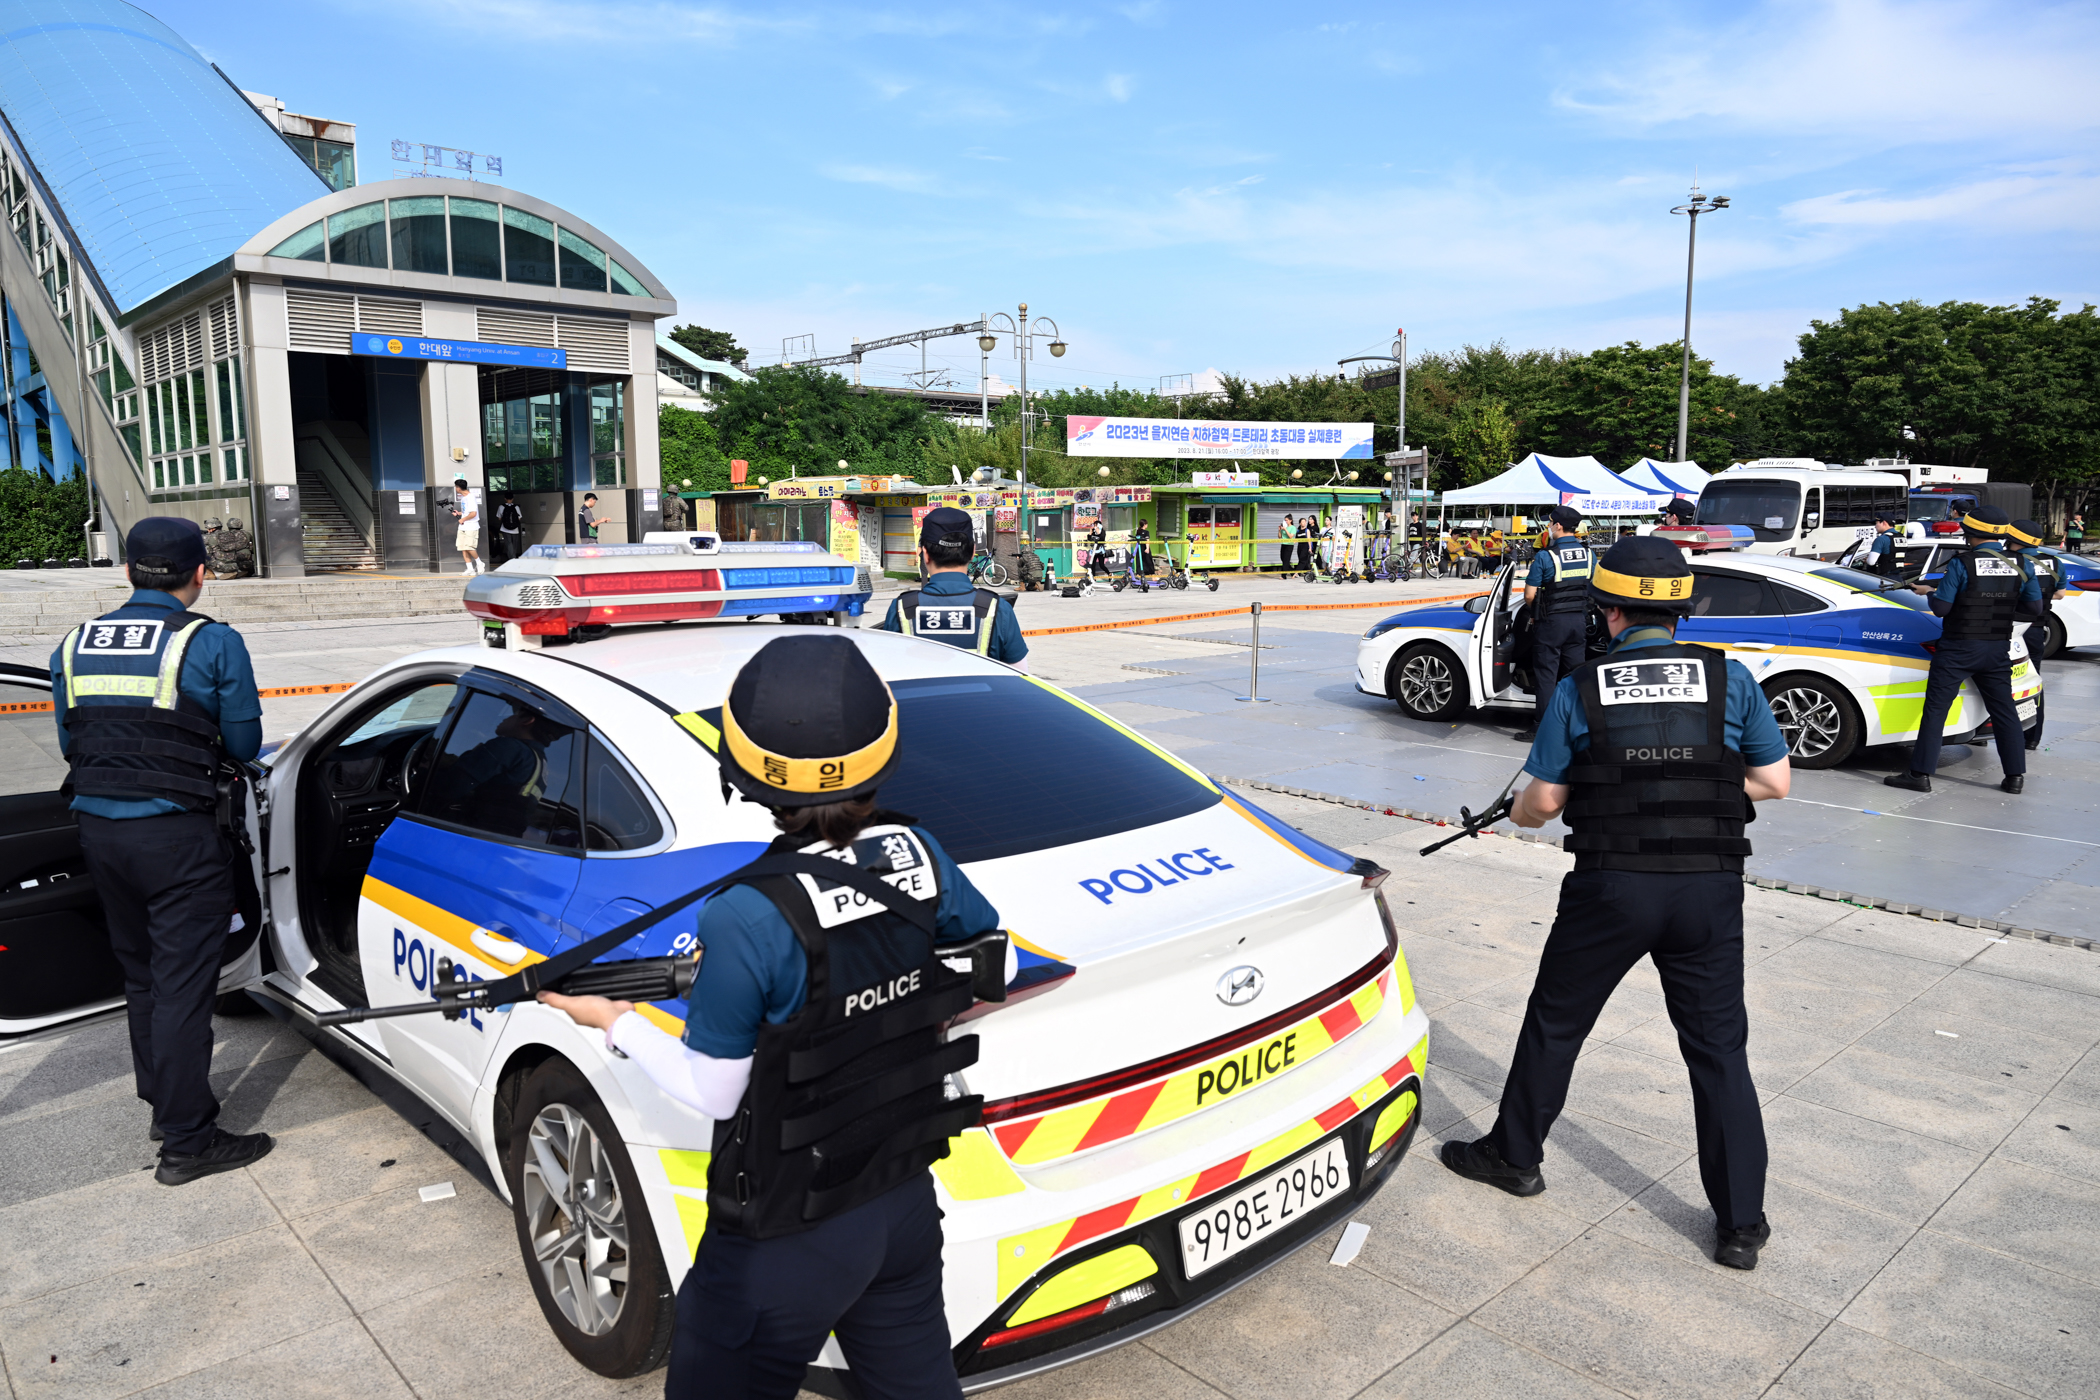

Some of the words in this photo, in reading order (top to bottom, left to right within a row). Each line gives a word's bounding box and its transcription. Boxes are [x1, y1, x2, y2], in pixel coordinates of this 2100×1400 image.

[418, 341, 453, 358] 한대앞
[456, 345, 482, 354] Hanyang
[551, 352, 559, 364] 2
[1106, 424, 1149, 441] 2023년
[1152, 425, 1190, 442] 을지연습
[1192, 426, 1230, 443] 지하철역
[1232, 427, 1268, 443] 드론테러
[1270, 428, 1306, 444] 초동대응
[1308, 428, 1342, 444] 실제훈련
[778, 486, 807, 497] 아메리카노
[137, 564, 164, 573] POLICE
[1639, 578, 1683, 597] 통일
[925, 611, 965, 629] 경찰
[93, 625, 147, 648] 경찰
[1861, 631, 1891, 640] 안산상록
[1891, 633, 1904, 641] 25
[1611, 663, 1691, 686] 경찰
[81, 676, 148, 696] POLICE
[274, 687, 313, 696] 경찰통제선
[1614, 686, 1694, 700] POLICE
[1626, 747, 1694, 761] POLICE
[763, 755, 845, 790] 통일
[1077, 846, 1235, 905] POLICE
[834, 873, 923, 913] POCE
[393, 927, 485, 1034] POLCE
[845, 969, 921, 1017] POLICE
[1196, 1031, 1298, 1106] POLICE
